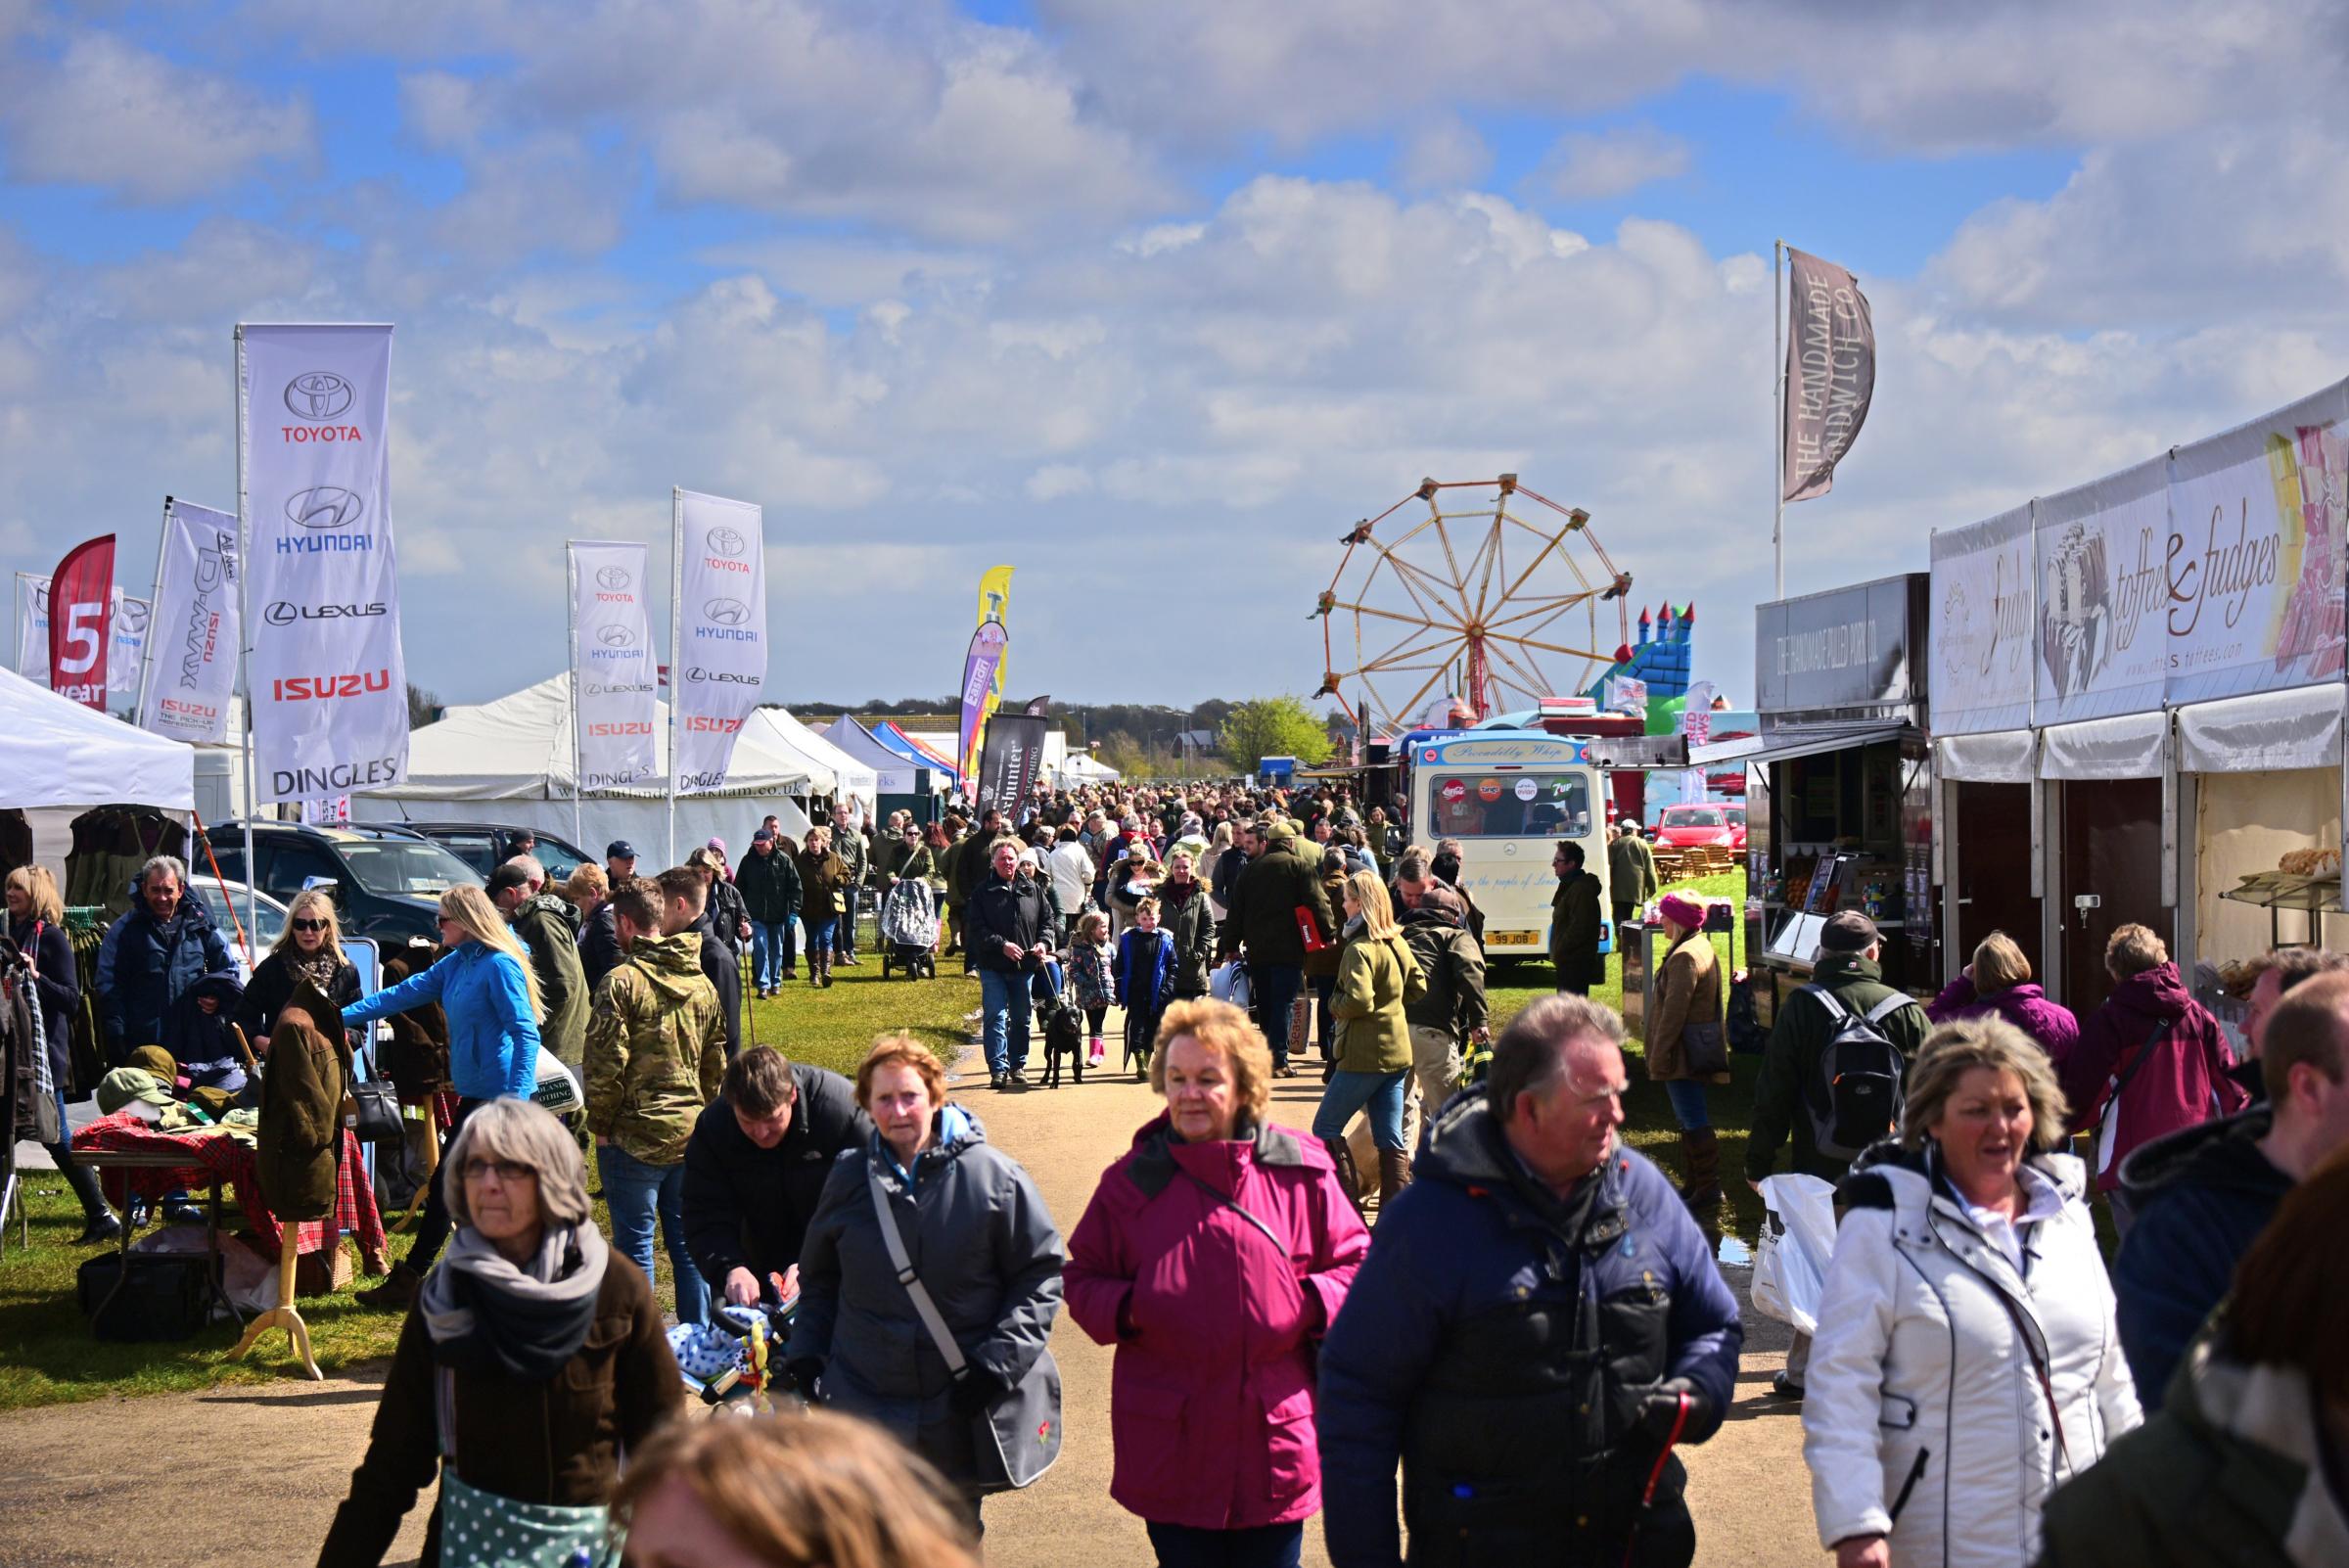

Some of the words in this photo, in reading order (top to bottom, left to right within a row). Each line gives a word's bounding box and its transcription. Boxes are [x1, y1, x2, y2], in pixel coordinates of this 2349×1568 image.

[1798, 273, 1832, 420] HANDMADE
[282, 426, 362, 443] TOYOTA
[1795, 431, 1822, 480] THE
[276, 533, 373, 554] HYUNDAI
[221, 533, 235, 578] All-New
[705, 558, 750, 574] TOYOTA
[2168, 497, 2280, 636] fudges
[596, 593, 633, 603] TOYOTA
[301, 602, 387, 619] LEXUS
[59, 602, 103, 674] 5
[204, 612, 219, 663] ISUZU
[696, 626, 758, 643] HYUNDAI
[591, 650, 644, 659] HYUNDAI
[273, 669, 391, 701] ISUZU
[710, 673, 760, 685] LEXUS
[604, 684, 653, 694] LEXUS
[161, 698, 216, 717] ISUZU
[589, 722, 654, 736] ISUZU
[686, 715, 744, 733] ISUZ
[1685, 712, 1698, 742] RED
[1452, 743, 1522, 760] Piccadilly
[1530, 743, 1562, 760] Whip
[274, 758, 396, 796] DINGLES
[589, 764, 649, 787] DINGLS
[1024, 747, 1038, 795] CLOTHING
[1001, 745, 1023, 819] erhunter
[1496, 935, 1507, 945] 99
[1510, 935, 1529, 945] JOB
[539, 1089, 572, 1102] OTHING
